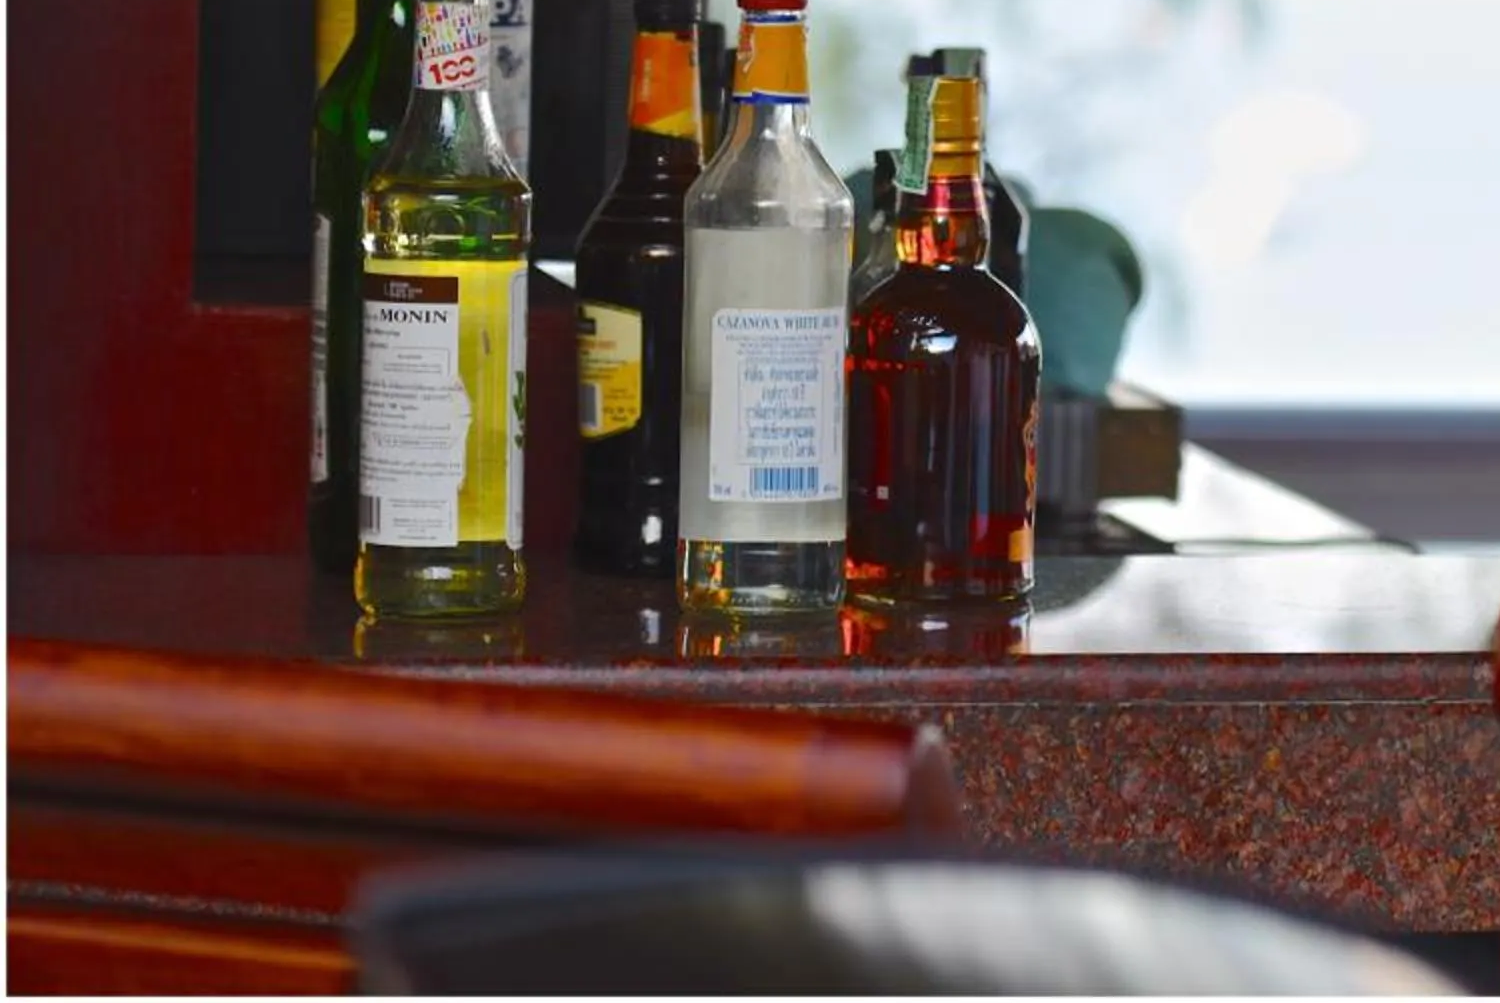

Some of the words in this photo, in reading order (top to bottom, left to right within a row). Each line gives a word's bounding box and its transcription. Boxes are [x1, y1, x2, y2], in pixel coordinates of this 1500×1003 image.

[428, 55, 476, 85] 100
[379, 308, 449, 324] MONIN
[717, 315, 780, 329] CAZANOVA
